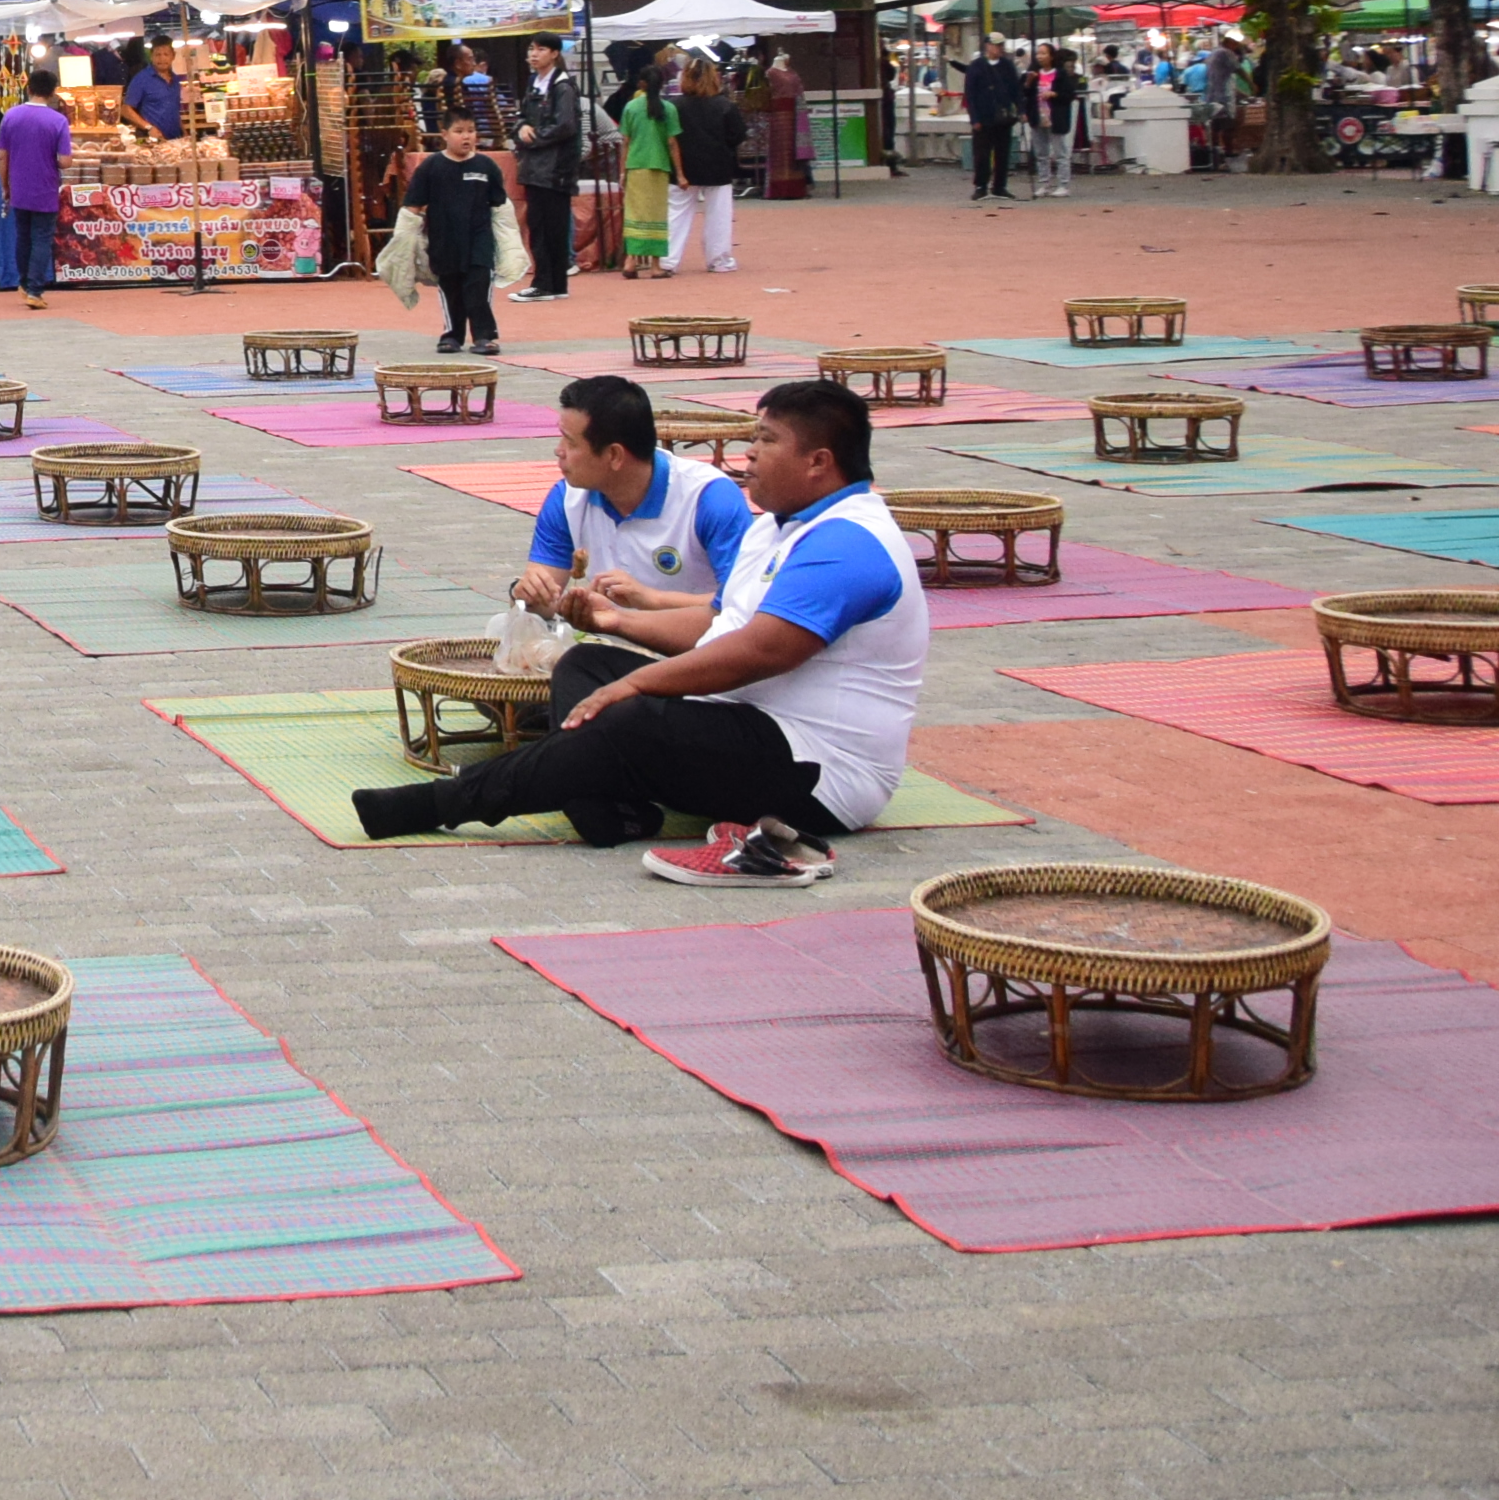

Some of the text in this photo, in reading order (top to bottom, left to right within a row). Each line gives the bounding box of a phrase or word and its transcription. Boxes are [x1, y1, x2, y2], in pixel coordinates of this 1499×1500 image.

[75, 216, 300, 239] หมูฝอย หมูสวรรค์ มูเค็ม หมูหยอง
[141, 240, 228, 261] น้ำพริกกกหมู
[179, 263, 260, 277] 08-1649534
